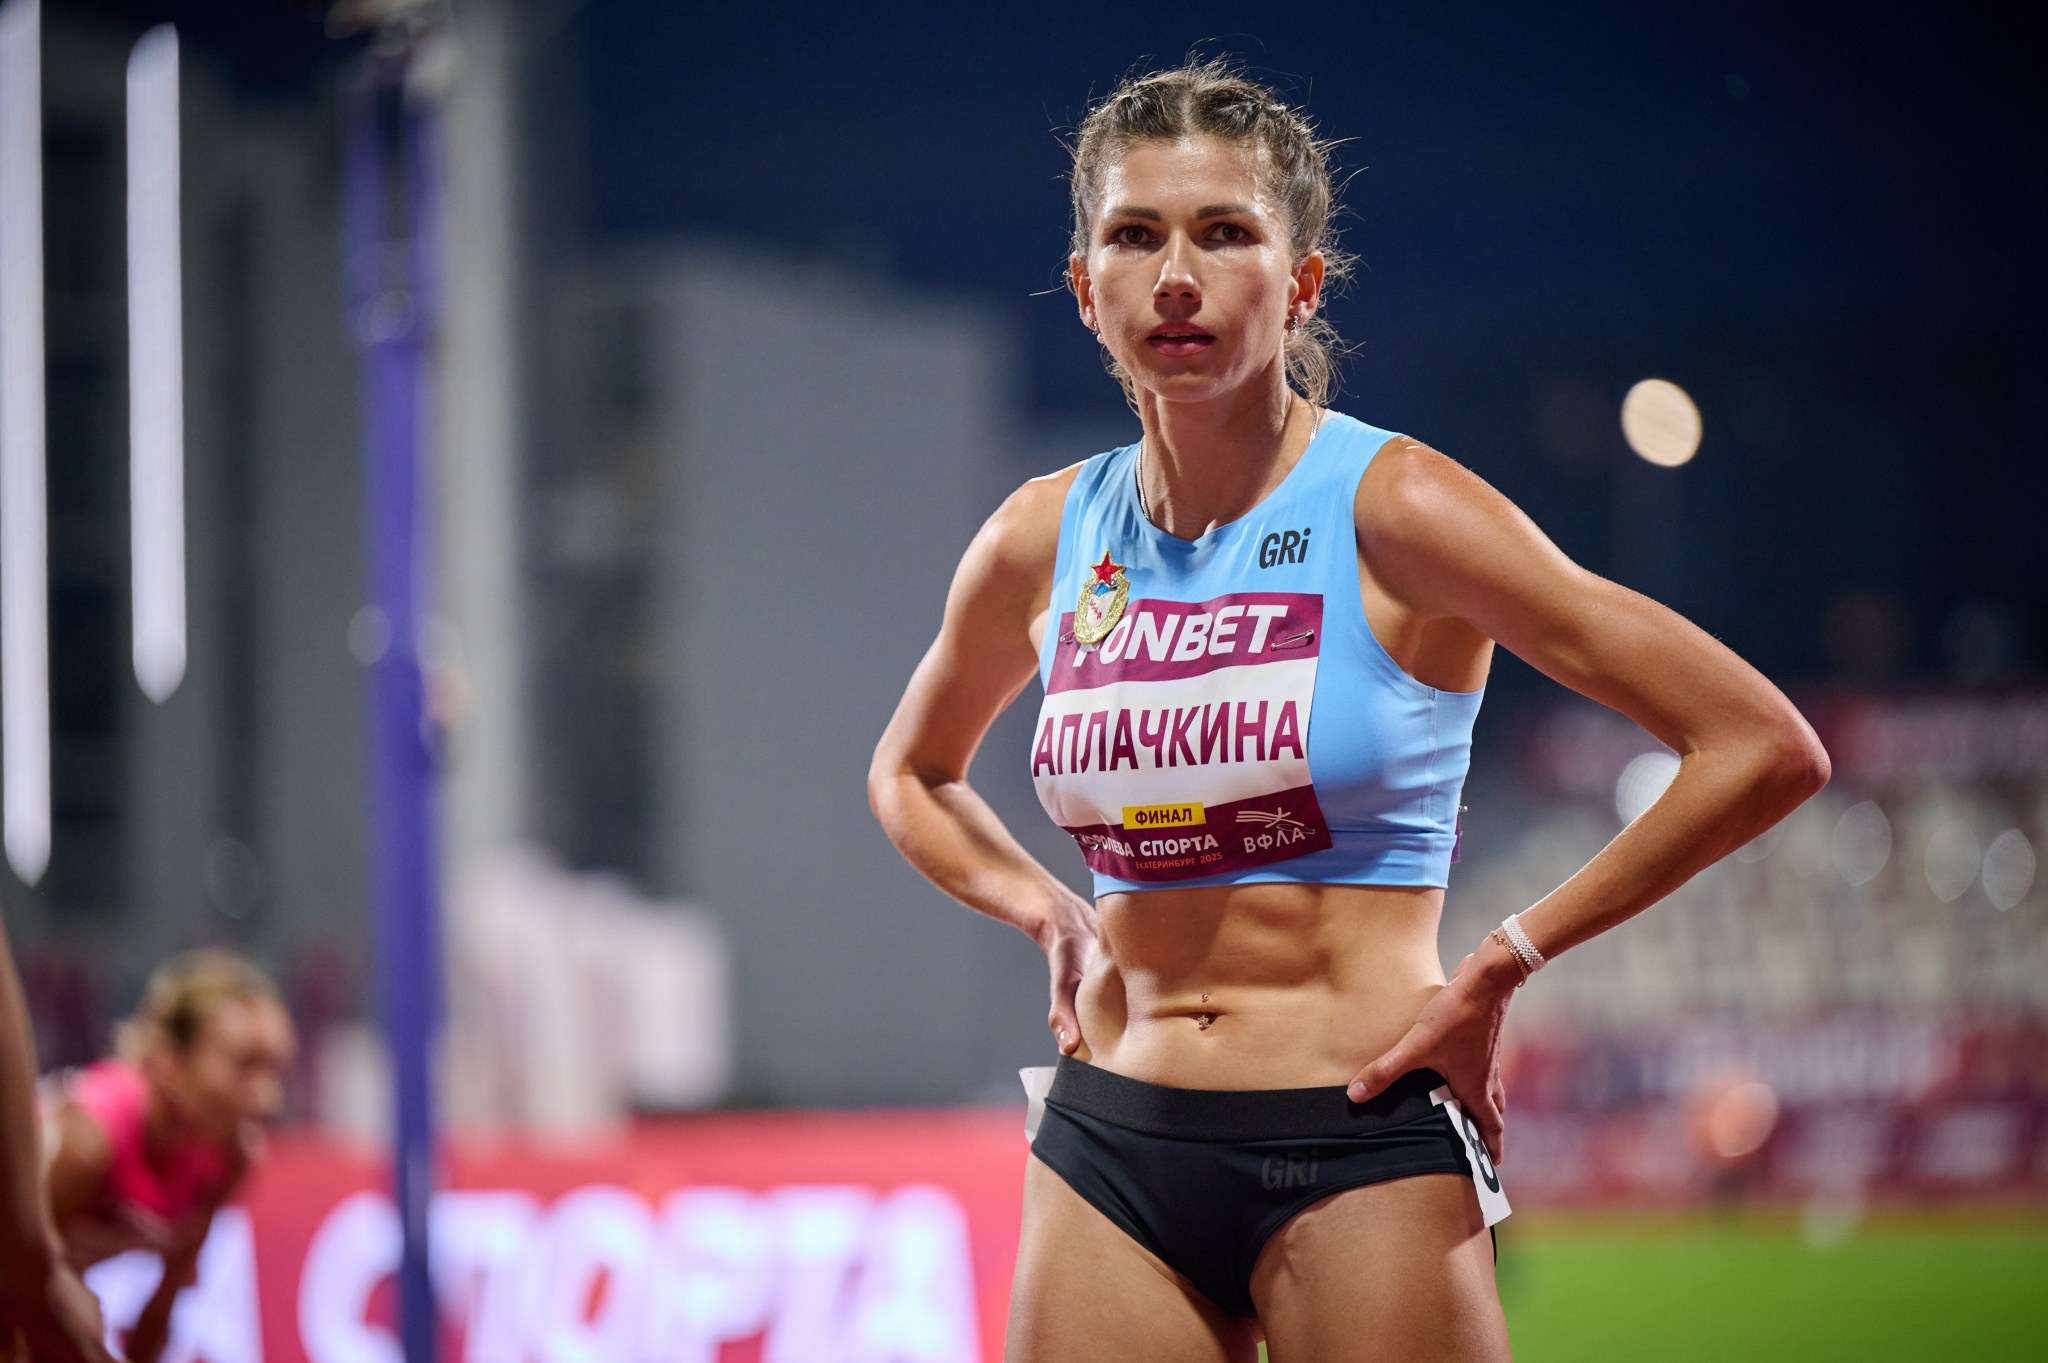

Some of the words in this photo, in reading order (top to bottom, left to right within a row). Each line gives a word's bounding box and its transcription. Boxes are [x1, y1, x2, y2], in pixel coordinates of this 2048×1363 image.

[1259, 528, 1311, 569] GRi
[1033, 701, 1305, 777] АПЛАЧКИНА
[1134, 808, 1193, 826] ФИНАЛ
[1139, 834, 1219, 857] СПОРТА
[1243, 827, 1306, 854] ВФЛА
[1135, 857, 1196, 870] ЕКАТЕРИНБУРГ
[1200, 852, 1223, 864] 2025
